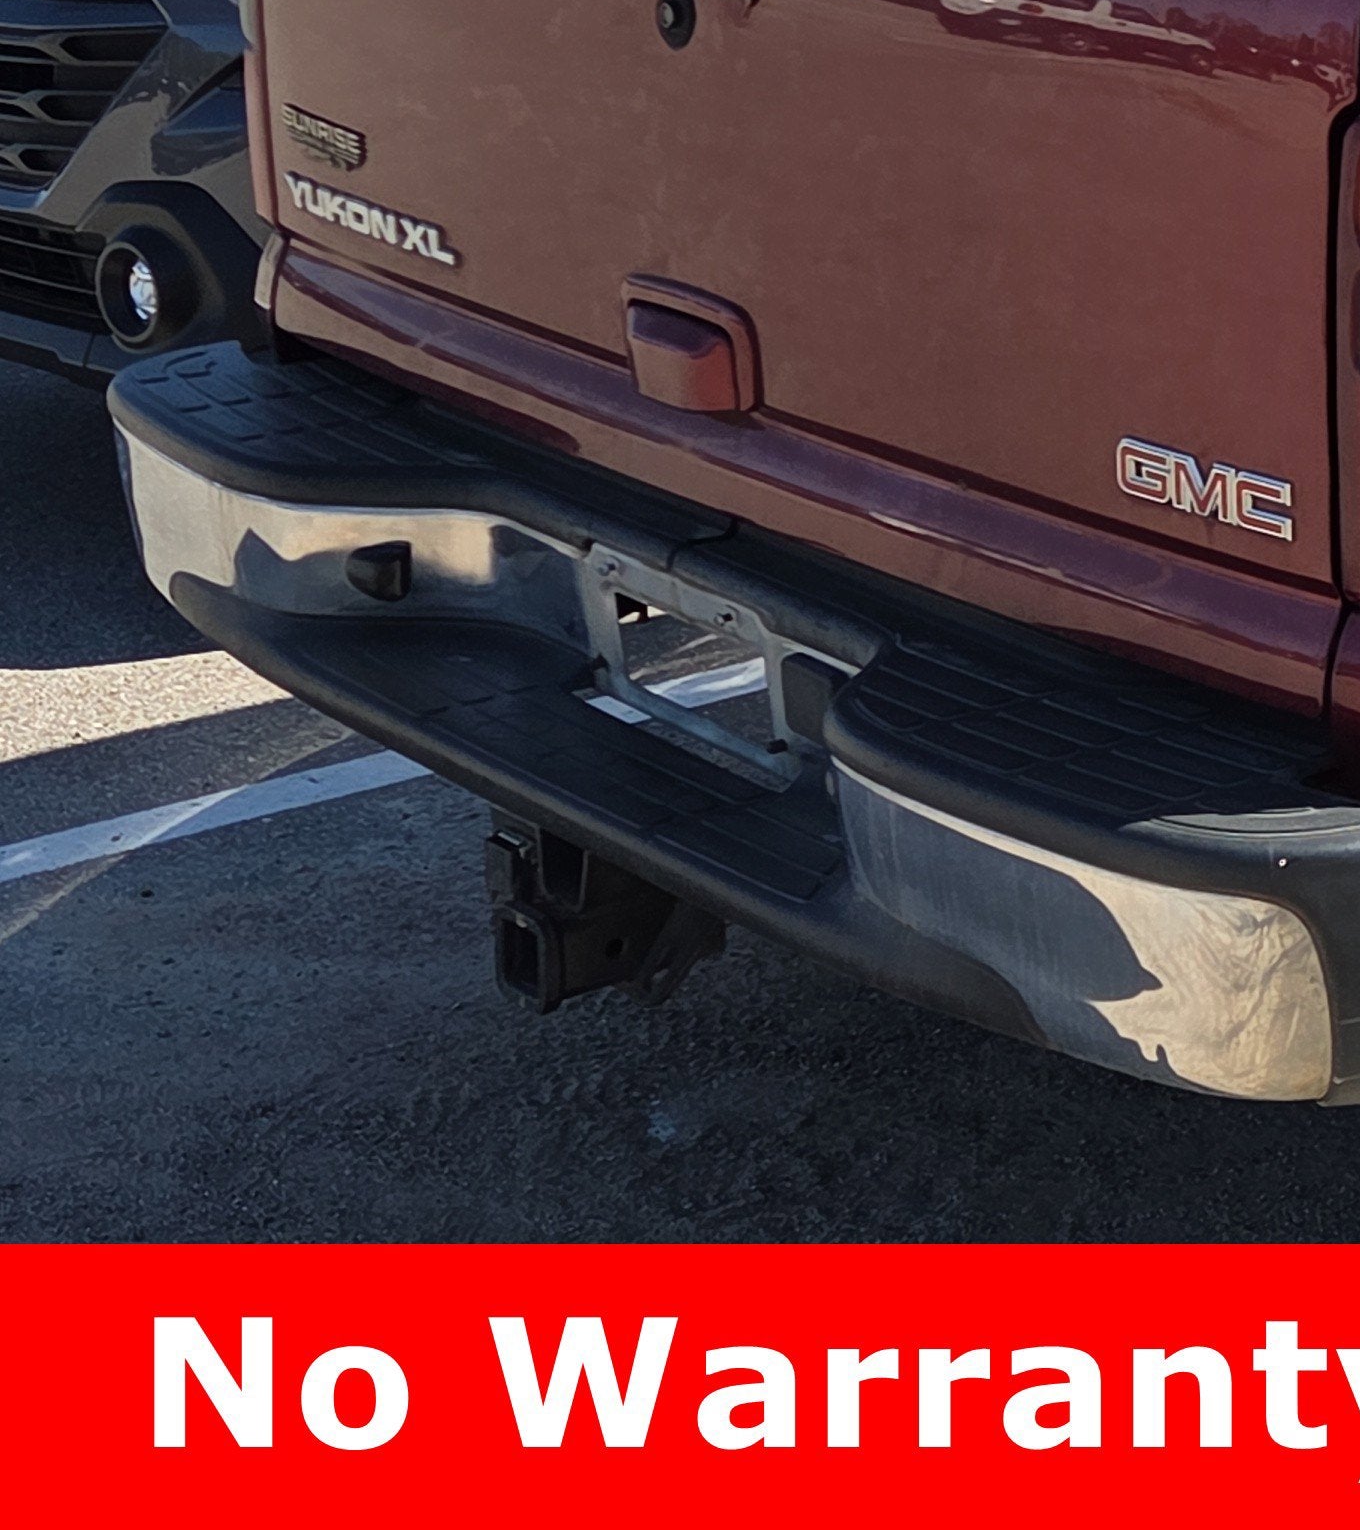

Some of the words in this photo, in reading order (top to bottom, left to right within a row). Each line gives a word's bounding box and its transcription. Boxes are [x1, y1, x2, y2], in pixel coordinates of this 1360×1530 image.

[284, 172, 398, 245] YUKON
[400, 218, 455, 266] XL
[1116, 437, 1293, 542] GMC
